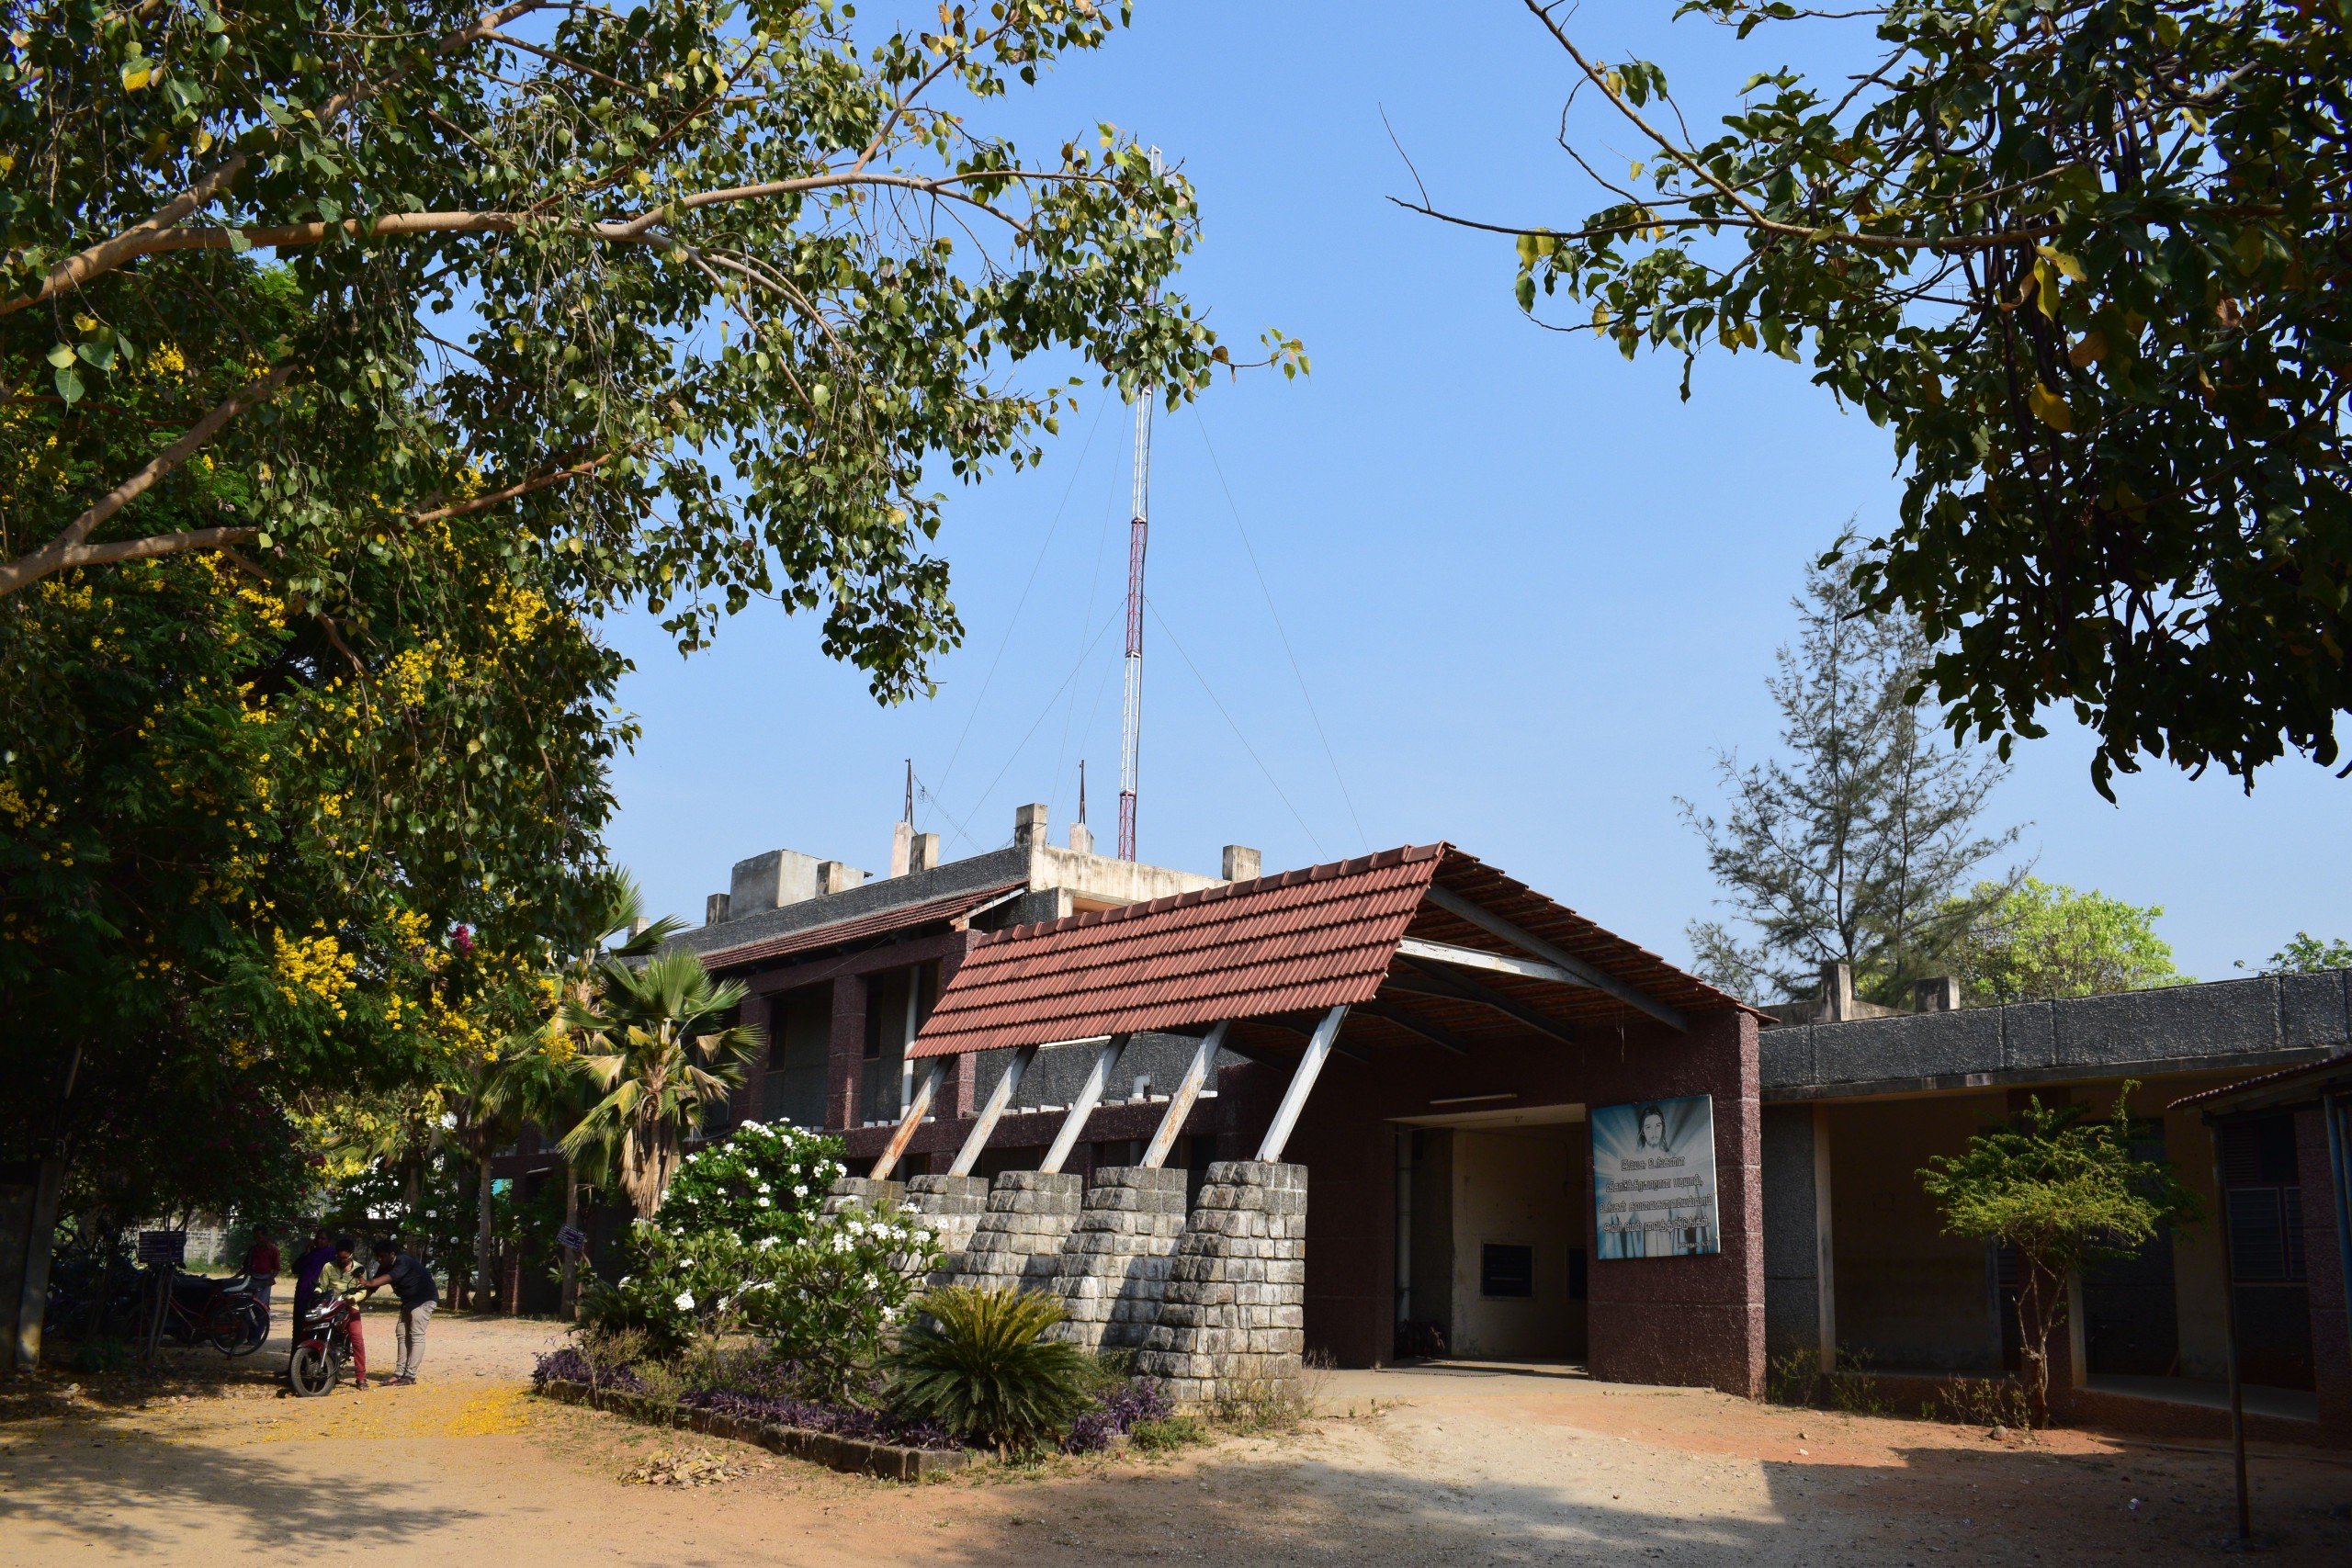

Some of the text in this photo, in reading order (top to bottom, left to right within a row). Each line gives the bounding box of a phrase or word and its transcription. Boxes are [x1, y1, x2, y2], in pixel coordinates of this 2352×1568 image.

[1648, 1156, 1685, 1168] உங்களை
[1600, 1201, 1626, 1213] உங்கள்
[1603, 1222, 1623, 1233] அவர்
